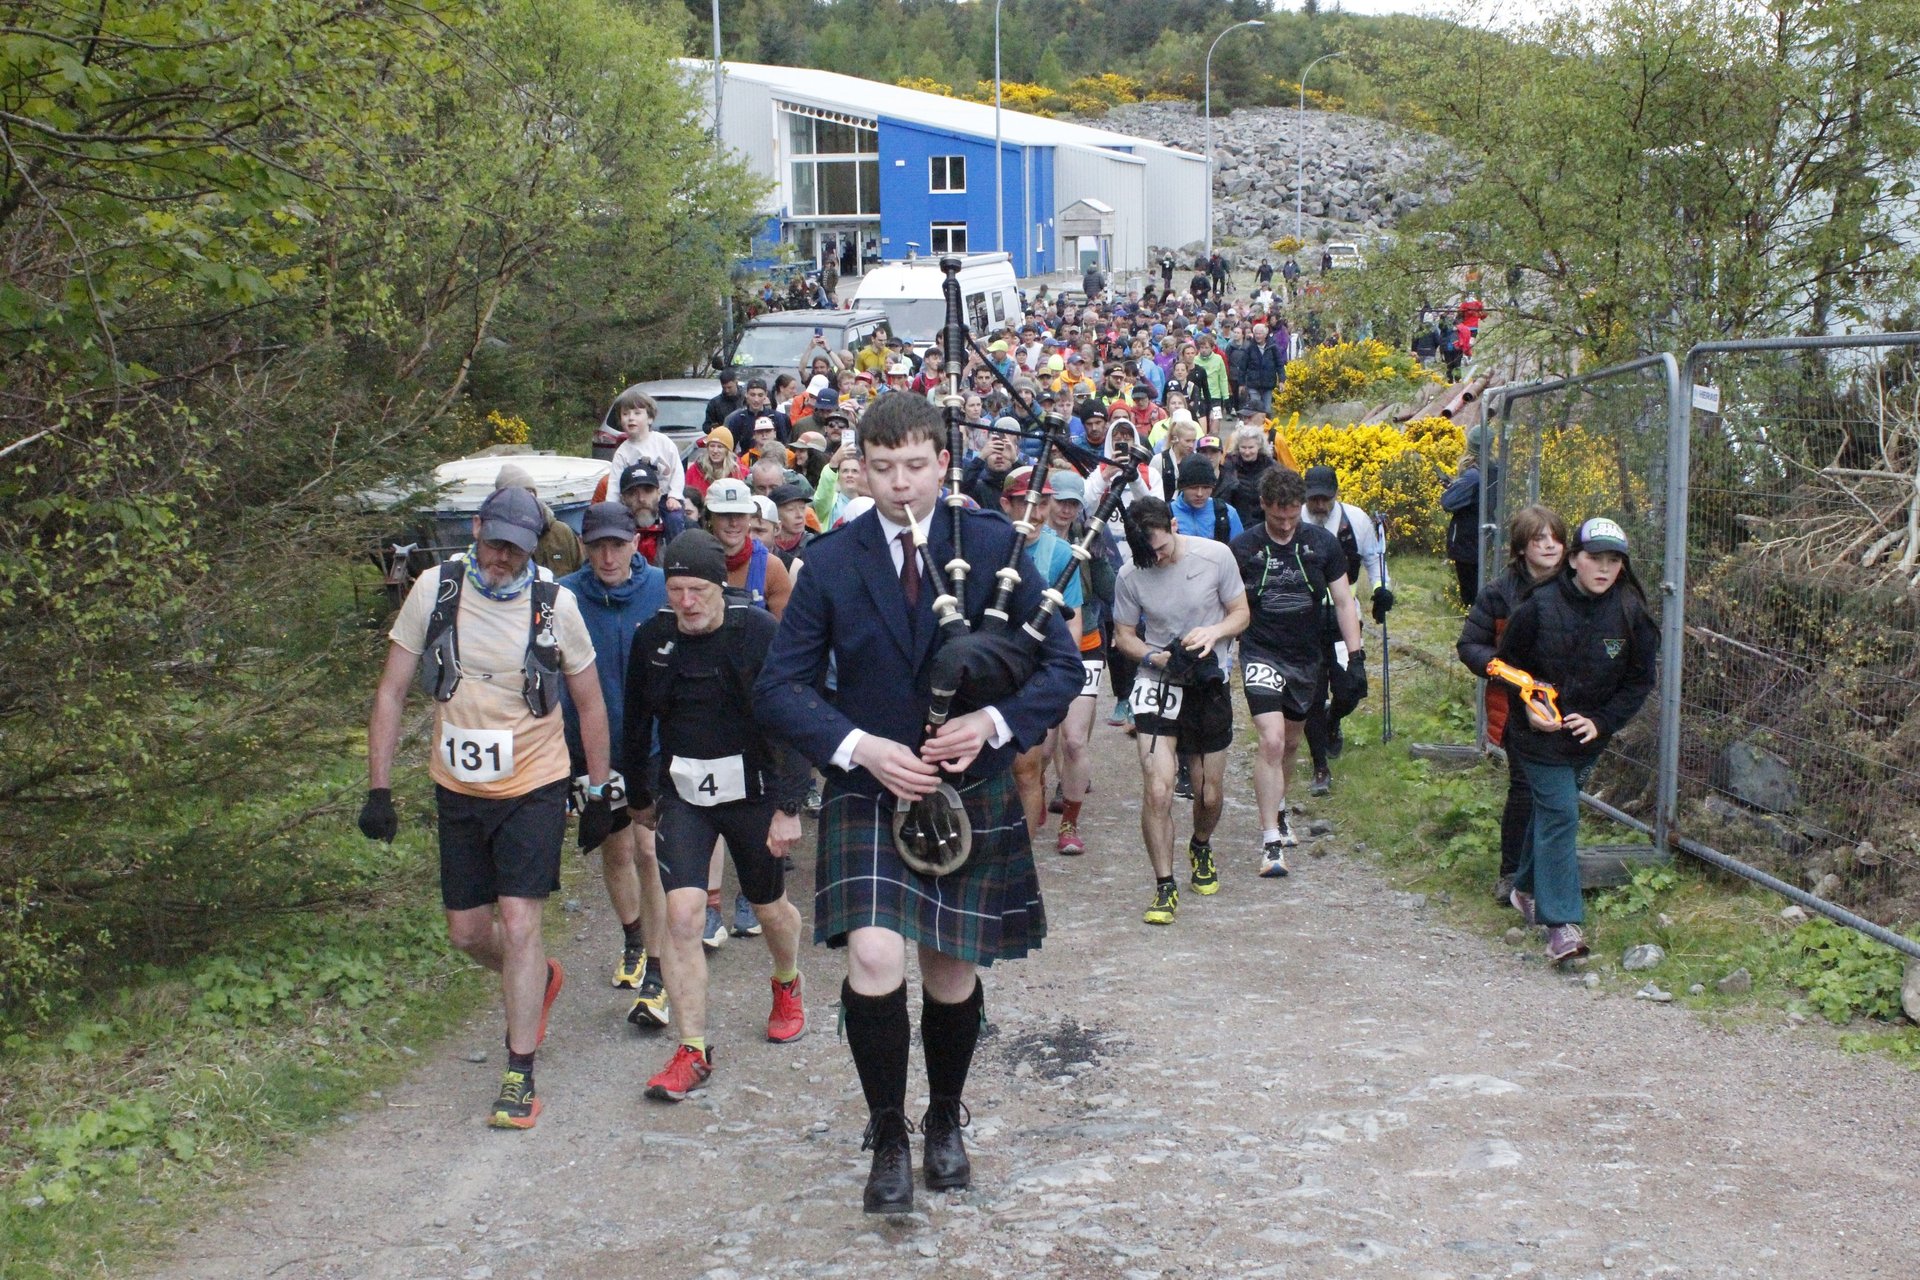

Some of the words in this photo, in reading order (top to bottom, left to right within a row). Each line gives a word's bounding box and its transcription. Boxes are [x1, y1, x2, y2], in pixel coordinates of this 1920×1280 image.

[1246, 665, 1285, 689] 229
[446, 737, 501, 772] 131
[698, 773, 719, 797] 4
